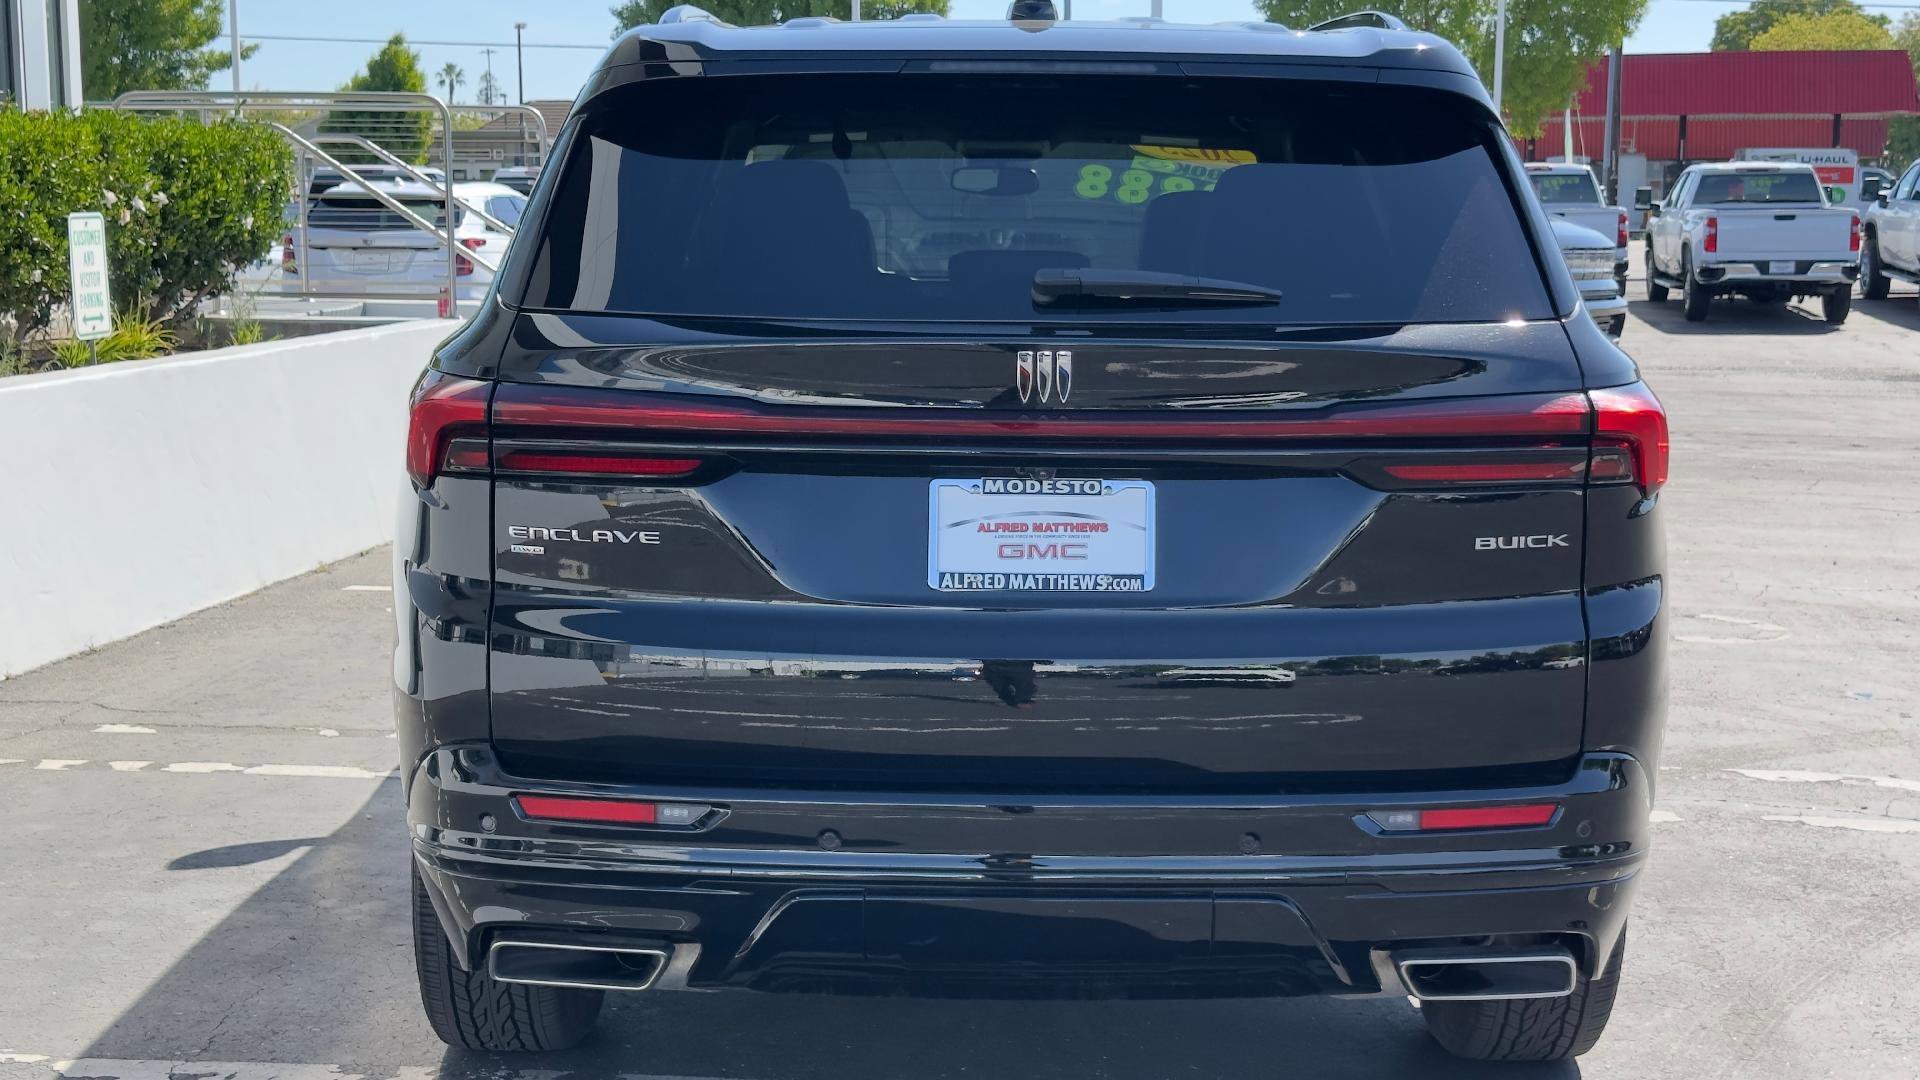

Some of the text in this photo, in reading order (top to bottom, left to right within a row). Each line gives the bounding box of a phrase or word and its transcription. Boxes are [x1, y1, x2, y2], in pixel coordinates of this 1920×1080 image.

[1801, 156, 1849, 164] U-HAUL
[73, 230, 101, 246] CUSTOMER
[83, 251, 95, 266] AND
[80, 271, 101, 288] VISITOR
[80, 292, 104, 309] PARKING
[984, 480, 1100, 494] MODESTO
[508, 526, 660, 544] ENCLAVE
[977, 523, 1108, 533] ALFRED MATTHEWS
[1475, 534, 1569, 550] BUICK
[997, 544, 1088, 560] GMC
[942, 574, 1005, 589] ALFRED
